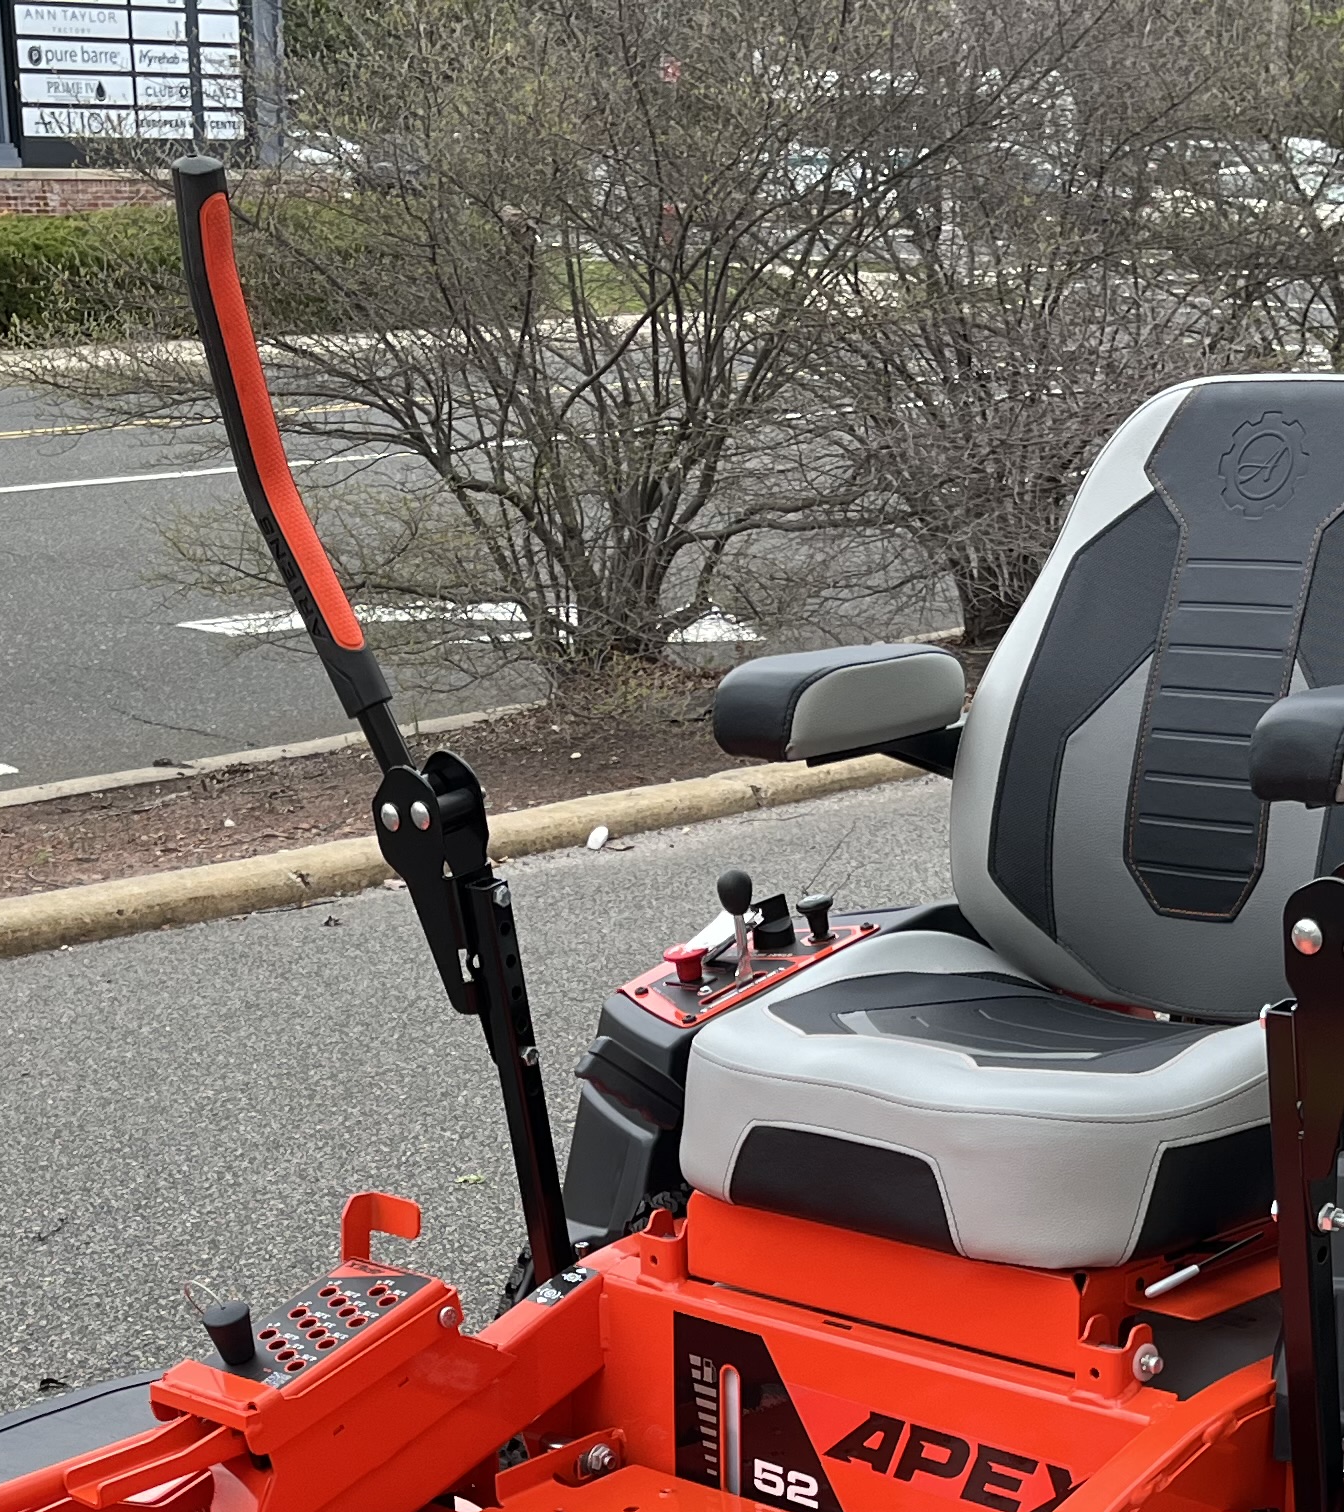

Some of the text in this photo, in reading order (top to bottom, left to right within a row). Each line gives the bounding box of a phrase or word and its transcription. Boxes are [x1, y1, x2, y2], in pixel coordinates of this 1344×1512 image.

[24, 8, 118, 24] ANN TAYLOR
[45, 45, 119, 65] pure barre
[46, 81, 83, 95] PRIME
[753, 1458, 820, 1510] 52
